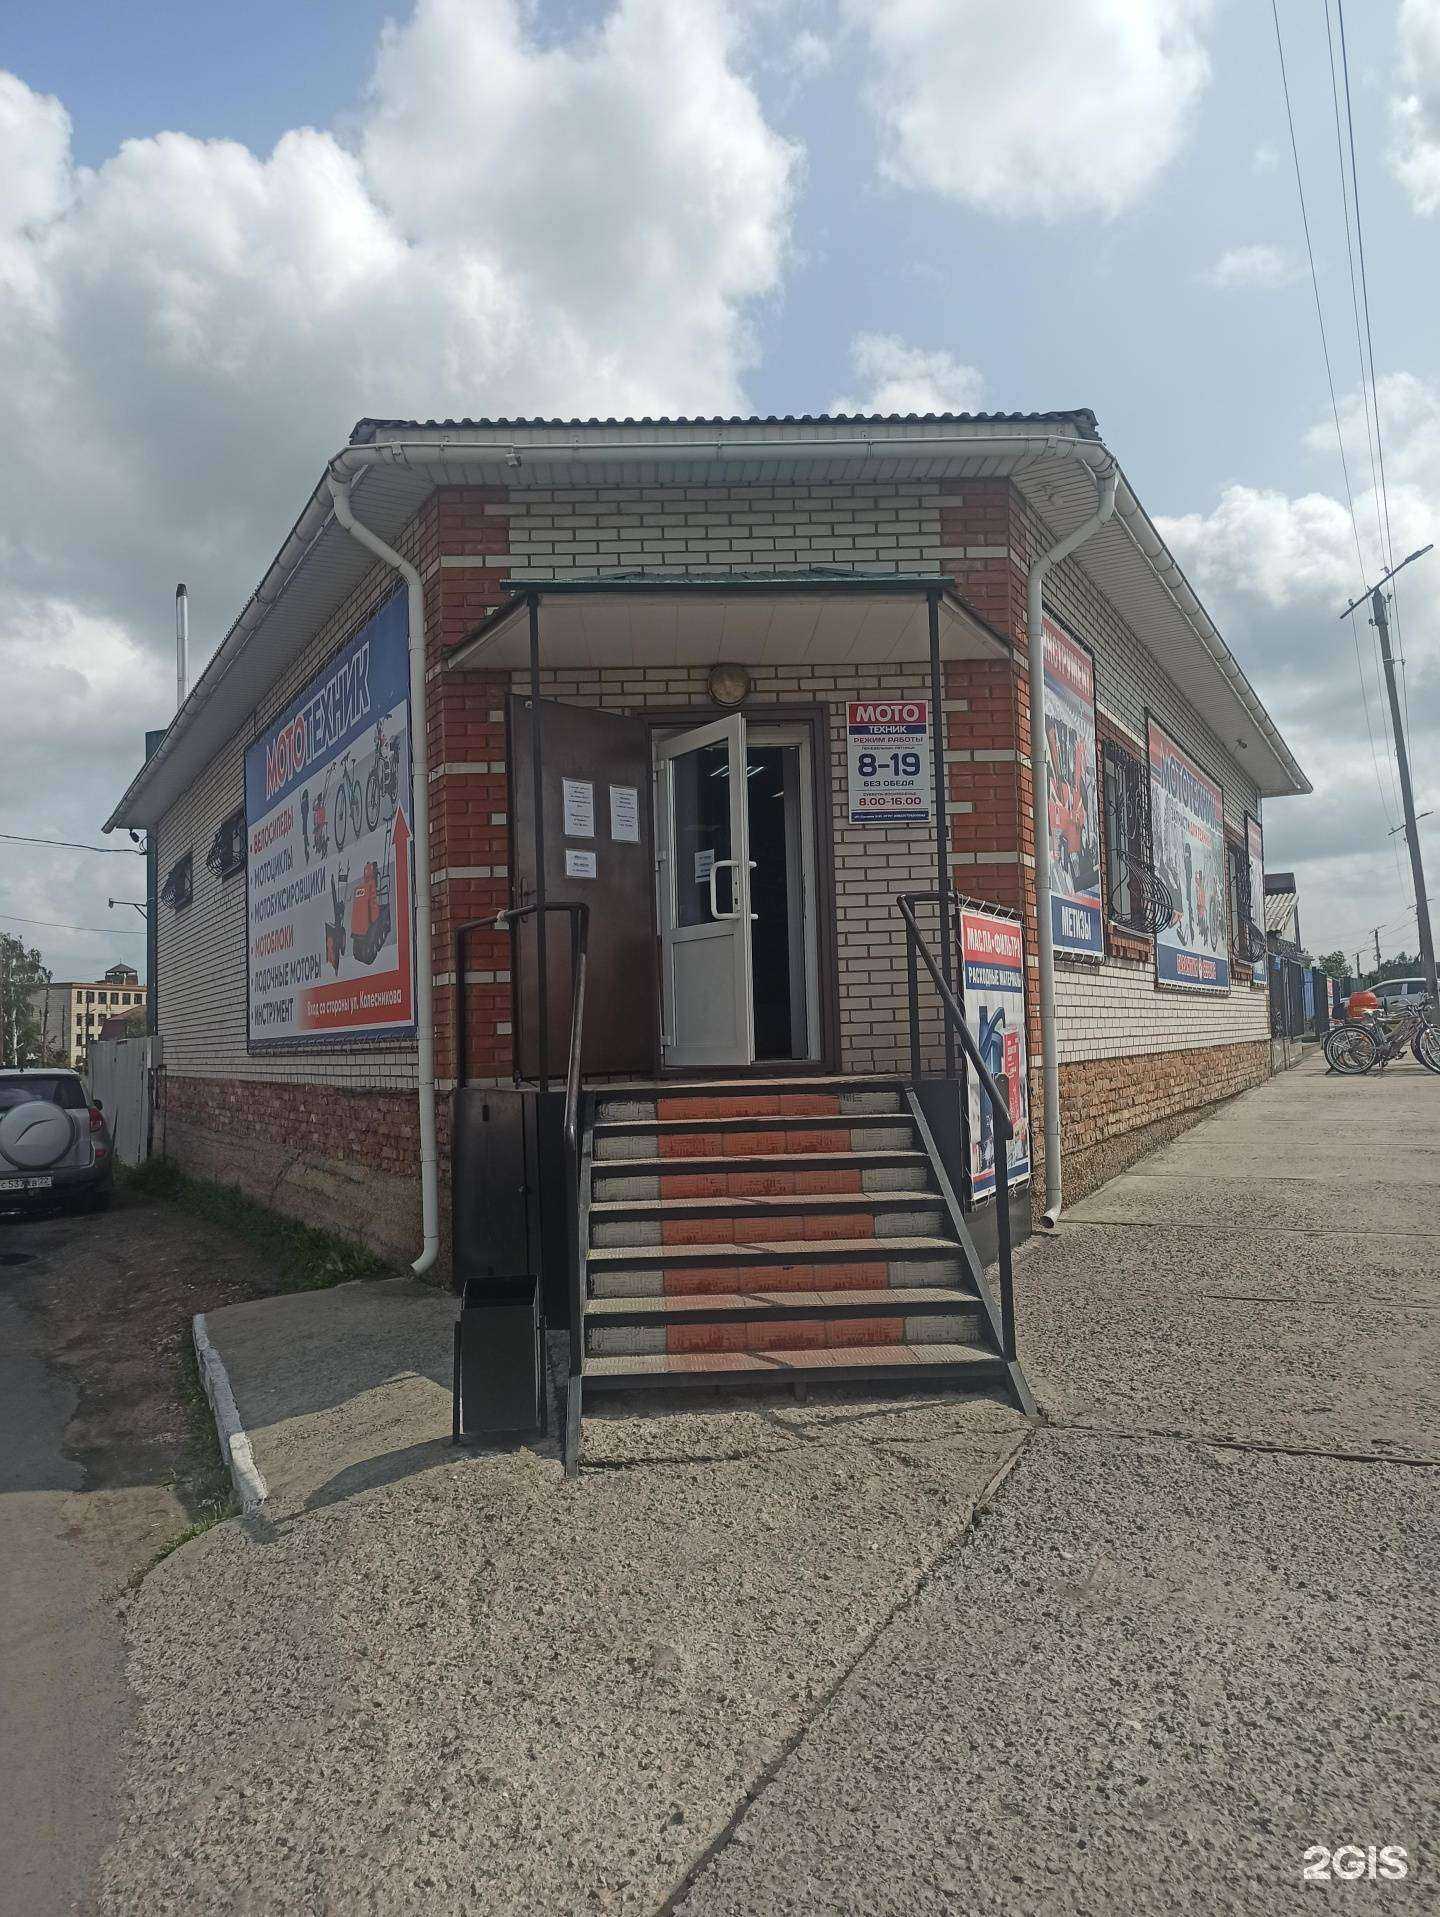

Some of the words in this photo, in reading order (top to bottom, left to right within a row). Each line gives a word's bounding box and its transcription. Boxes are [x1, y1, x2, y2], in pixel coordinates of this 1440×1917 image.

[265, 640, 371, 801] МОТОТЕХНИК
[856, 704, 920, 722] МОТО
[868, 725, 908, 734] ТЕХНИК
[857, 752, 921, 777] 8-19
[858, 796, 922, 806] 8.00-16.00
[253, 807, 294, 855] ВЕЛОСИПЕДЫ
[254, 846, 294, 889] МОТОЦИКЛЫ
[254, 866, 326, 923] МОТОБУКСИРОВЩИКИ
[1061, 905, 1092, 941] МЕТИЗЫ
[254, 925, 294, 959] МОТОБЛОКИ
[254, 959, 289, 993] ЛОДОЧНЫЕ
[289, 953, 322, 984] МОТОРЫ
[254, 998, 294, 1026] ИНСТРУМЕНТ
